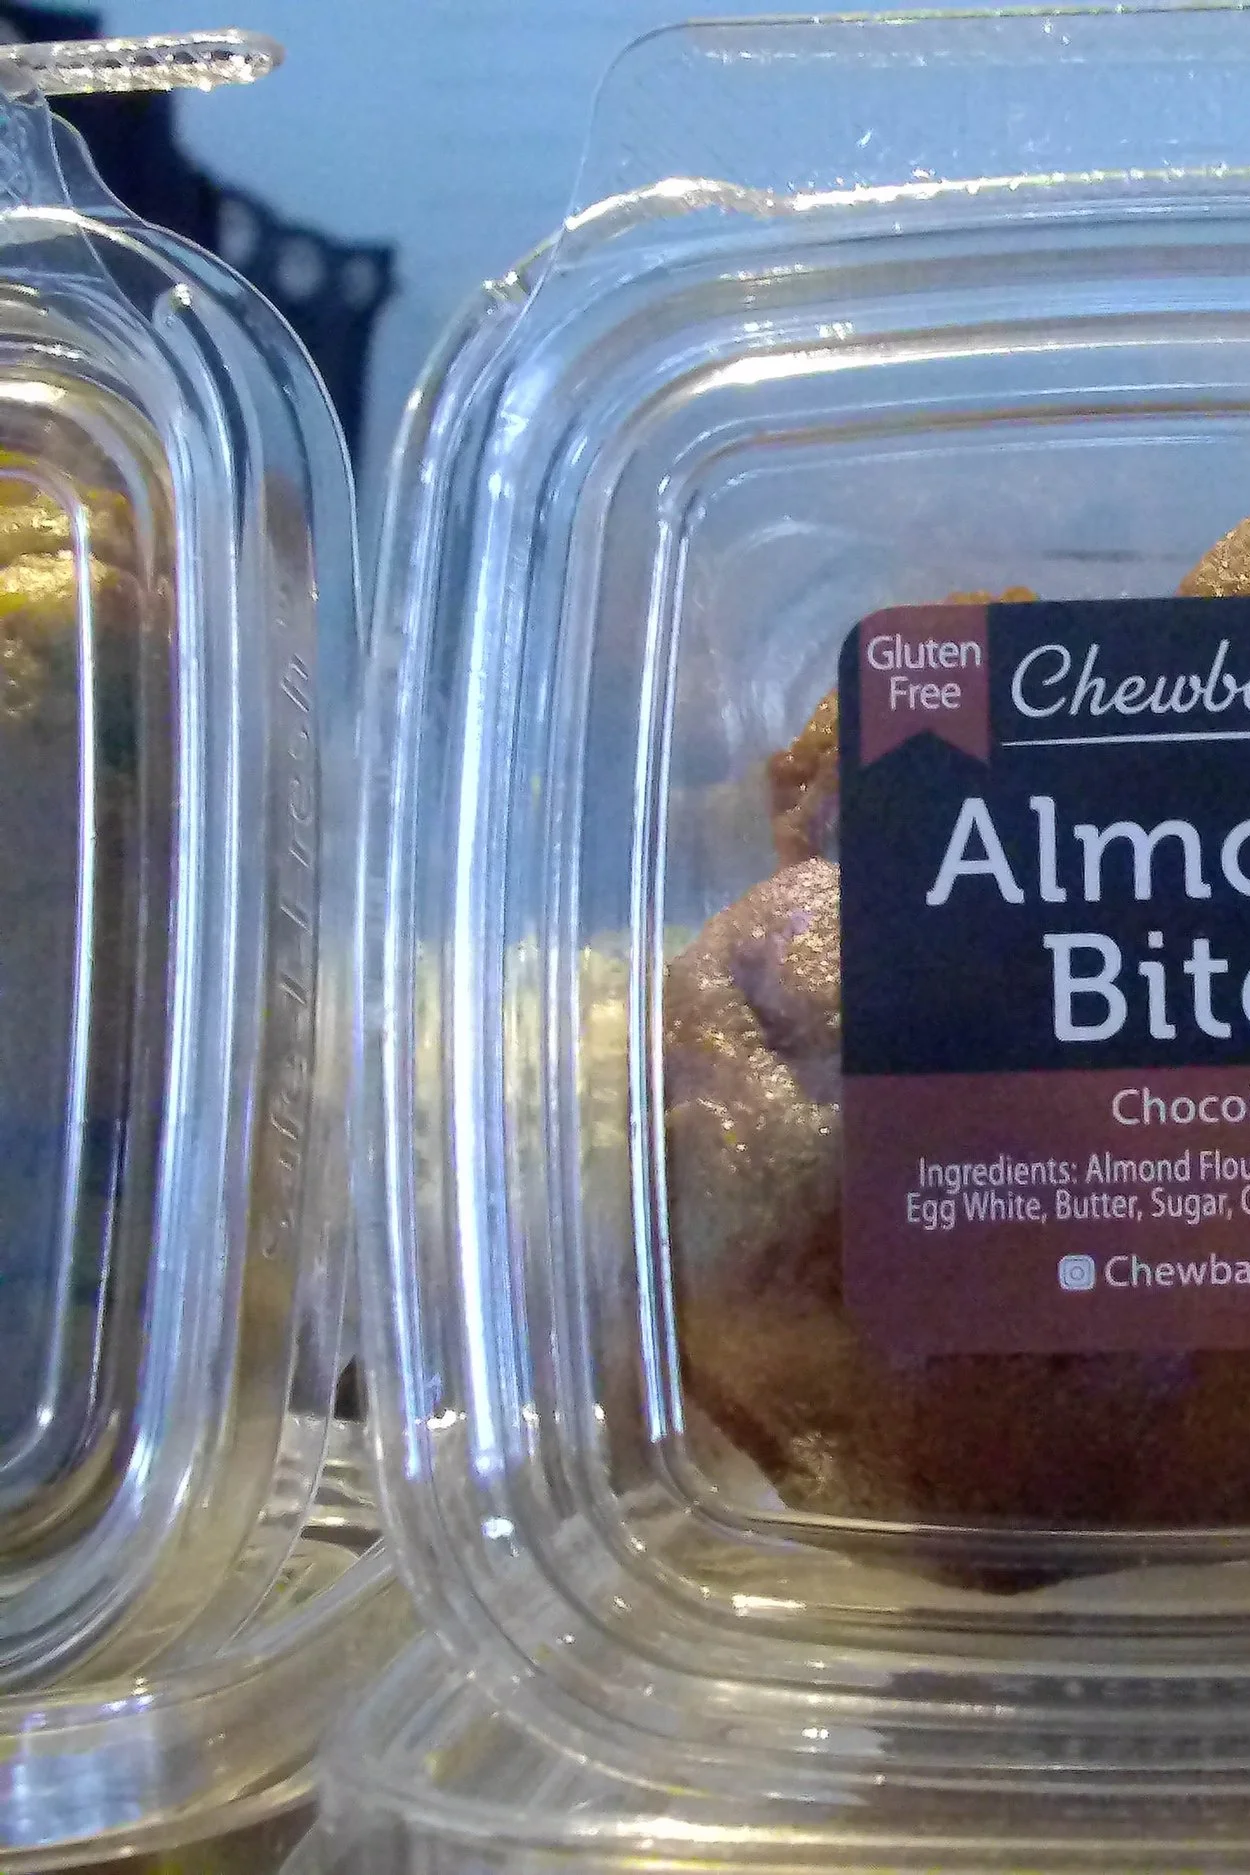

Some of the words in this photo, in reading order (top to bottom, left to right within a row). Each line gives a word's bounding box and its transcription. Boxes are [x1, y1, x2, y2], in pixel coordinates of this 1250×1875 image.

[866, 635, 982, 670] Gluten
[889, 677, 962, 711] Free
[918, 1153, 1078, 1194] Ingredients:
[1085, 1149, 1191, 1184] Almond
[906, 1191, 957, 1231] Egg
[962, 1189, 1048, 1224] White,
[1054, 1187, 1144, 1223] Butter,
[1150, 1186, 1234, 1226] Sugar,
